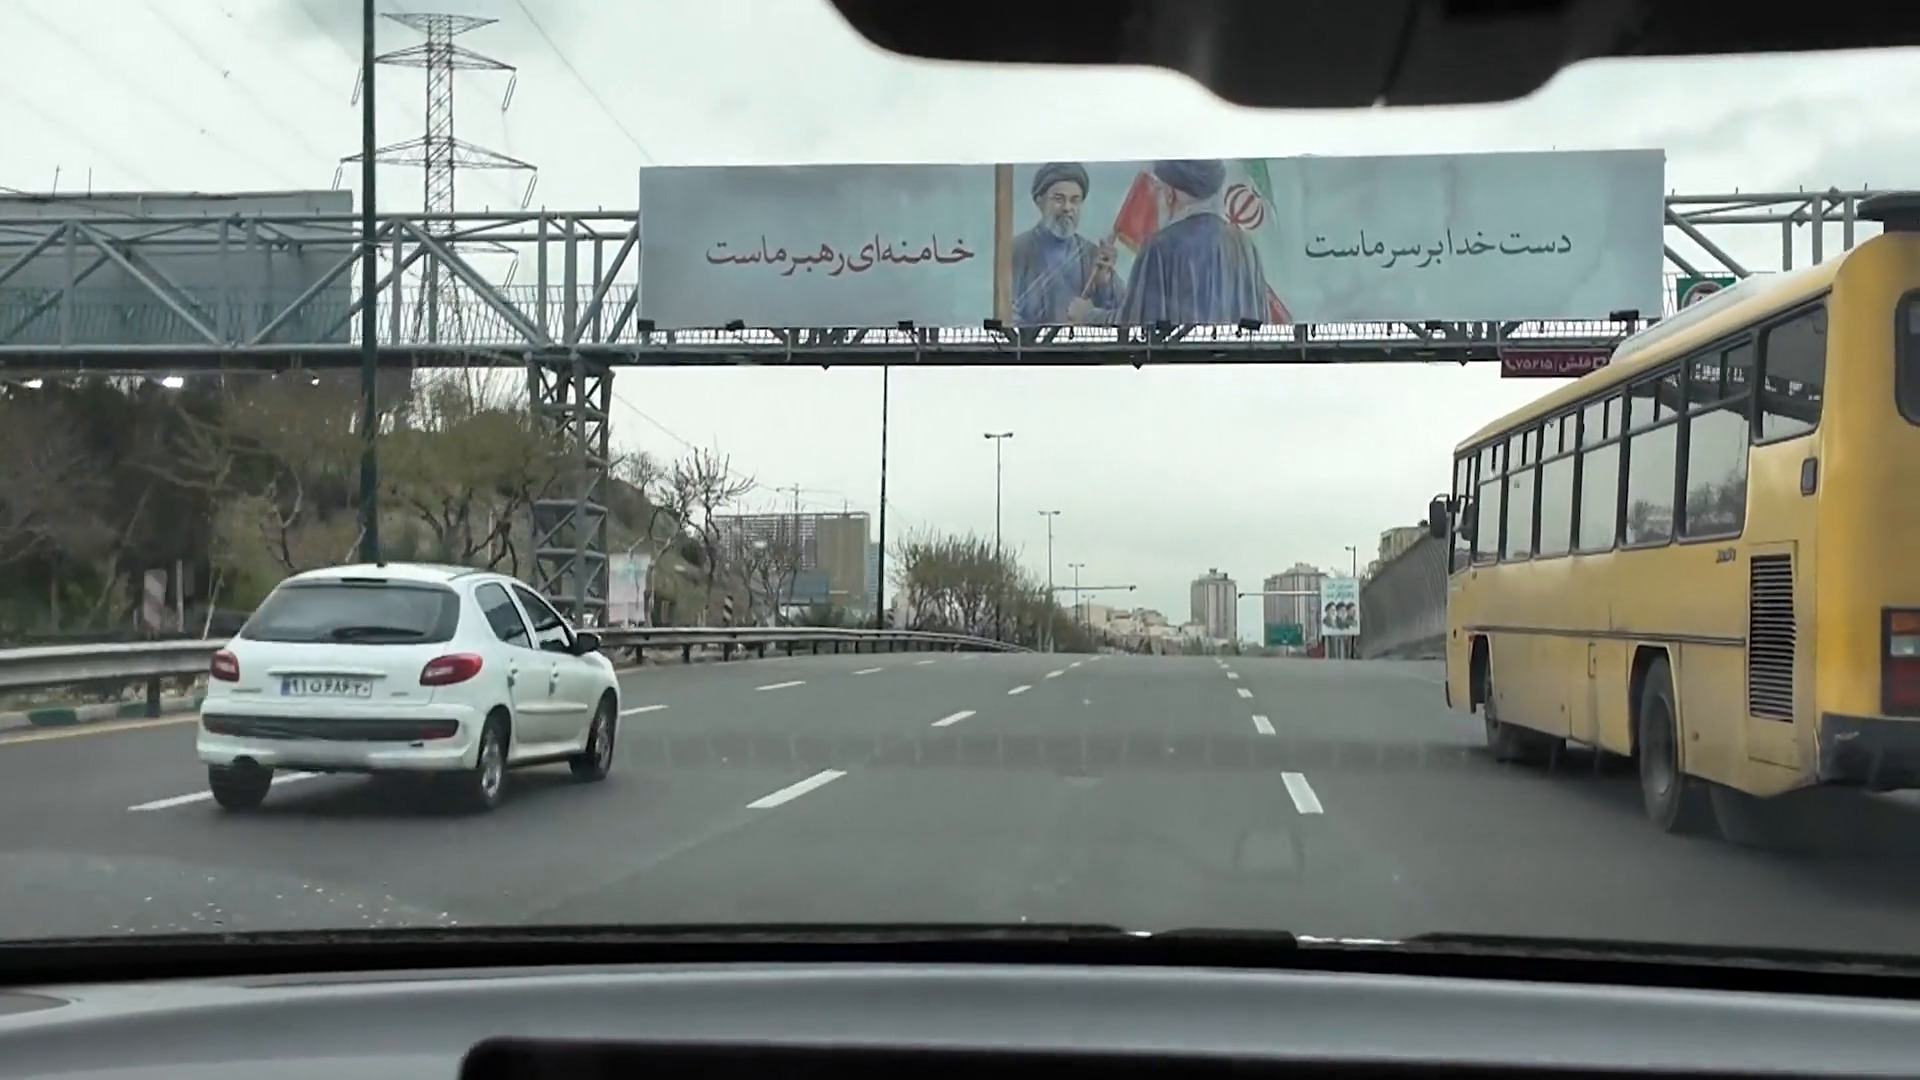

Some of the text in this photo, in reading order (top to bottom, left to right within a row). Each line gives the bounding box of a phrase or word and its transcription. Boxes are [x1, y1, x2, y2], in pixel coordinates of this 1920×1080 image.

[705, 234, 787, 265] ماست
[780, 242, 844, 277] رهبر
[1304, 227, 1572, 269] دست خدا بر سر ماست
